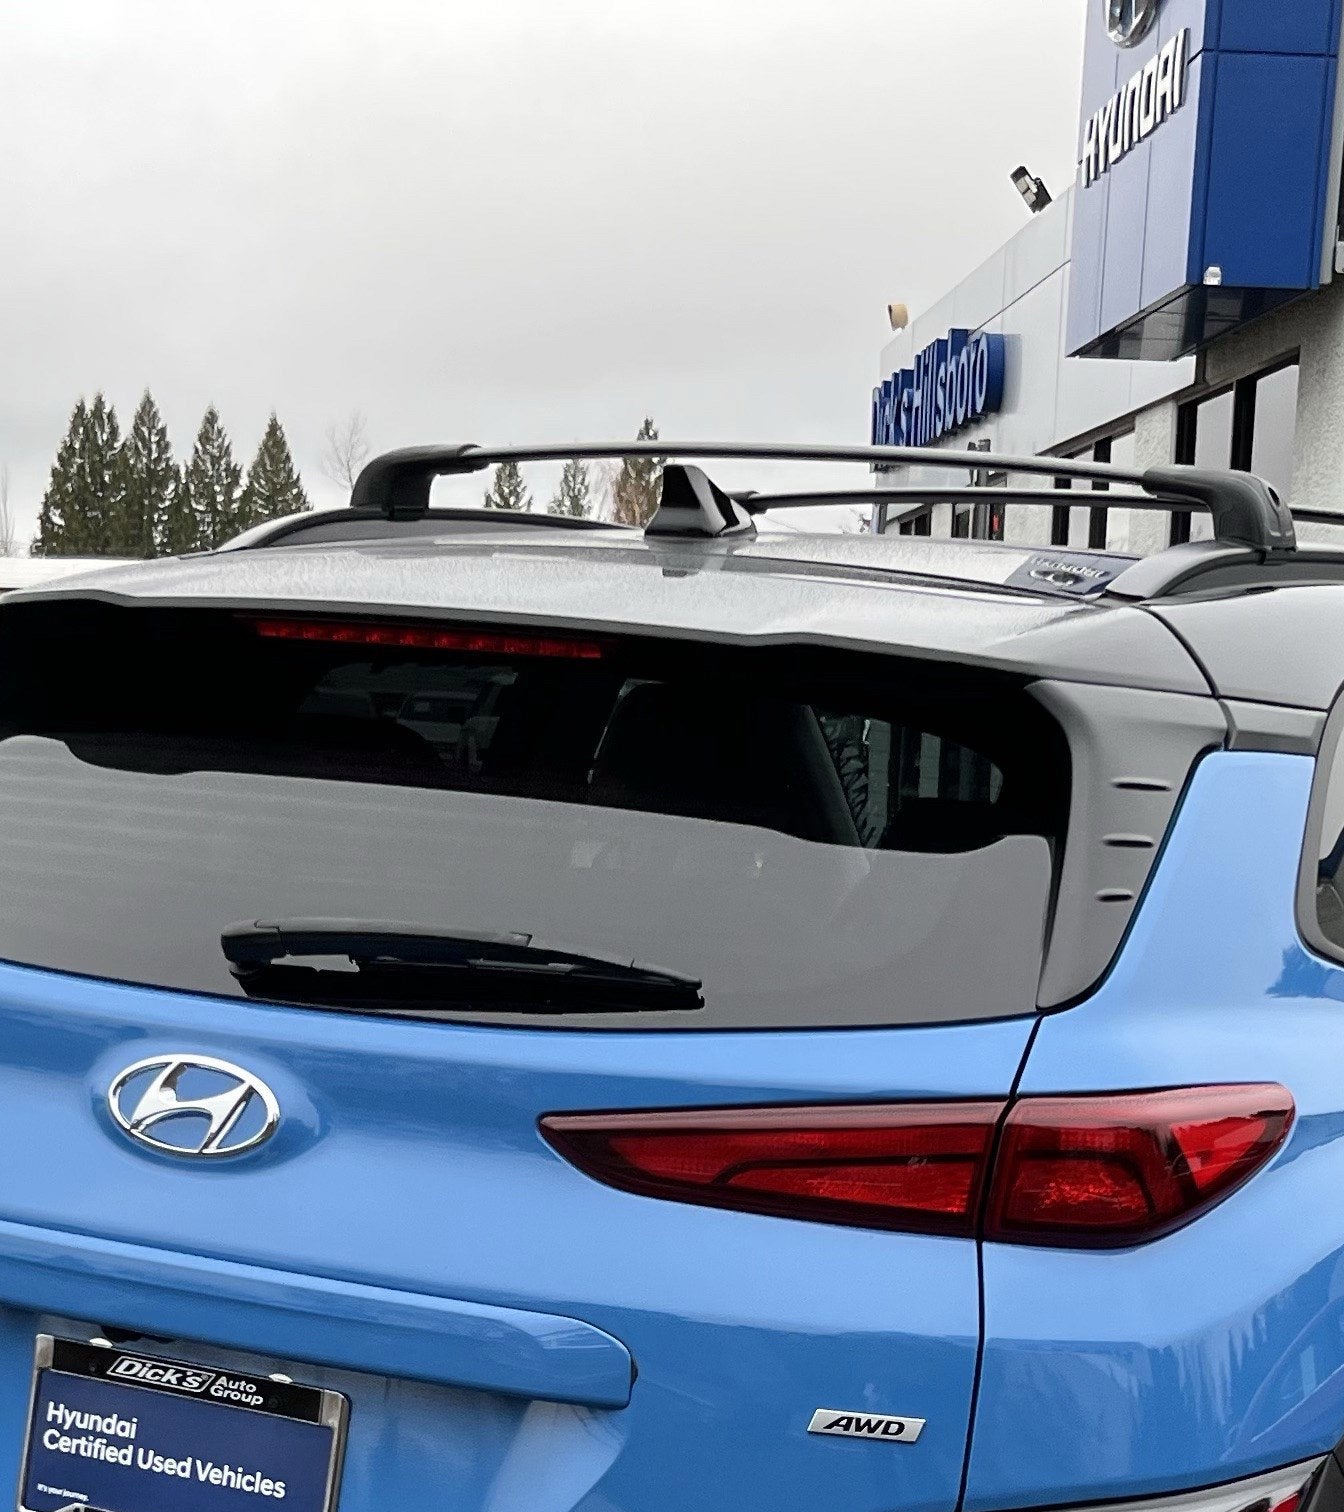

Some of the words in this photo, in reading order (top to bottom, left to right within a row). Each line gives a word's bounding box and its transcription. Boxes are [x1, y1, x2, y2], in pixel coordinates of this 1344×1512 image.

[1081, 28, 1189, 188] HYUNDAI
[911, 328, 998, 446] Hillsboro
[115, 1359, 203, 1389] Dick's
[215, 1376, 257, 1393] Auto
[210, 1385, 264, 1406] Group
[46, 1401, 138, 1439] Hyundai
[823, 1416, 905, 1436] AWD
[43, 1429, 134, 1466] Certified
[137, 1447, 193, 1479] Used
[195, 1459, 287, 1499] Vehicles
